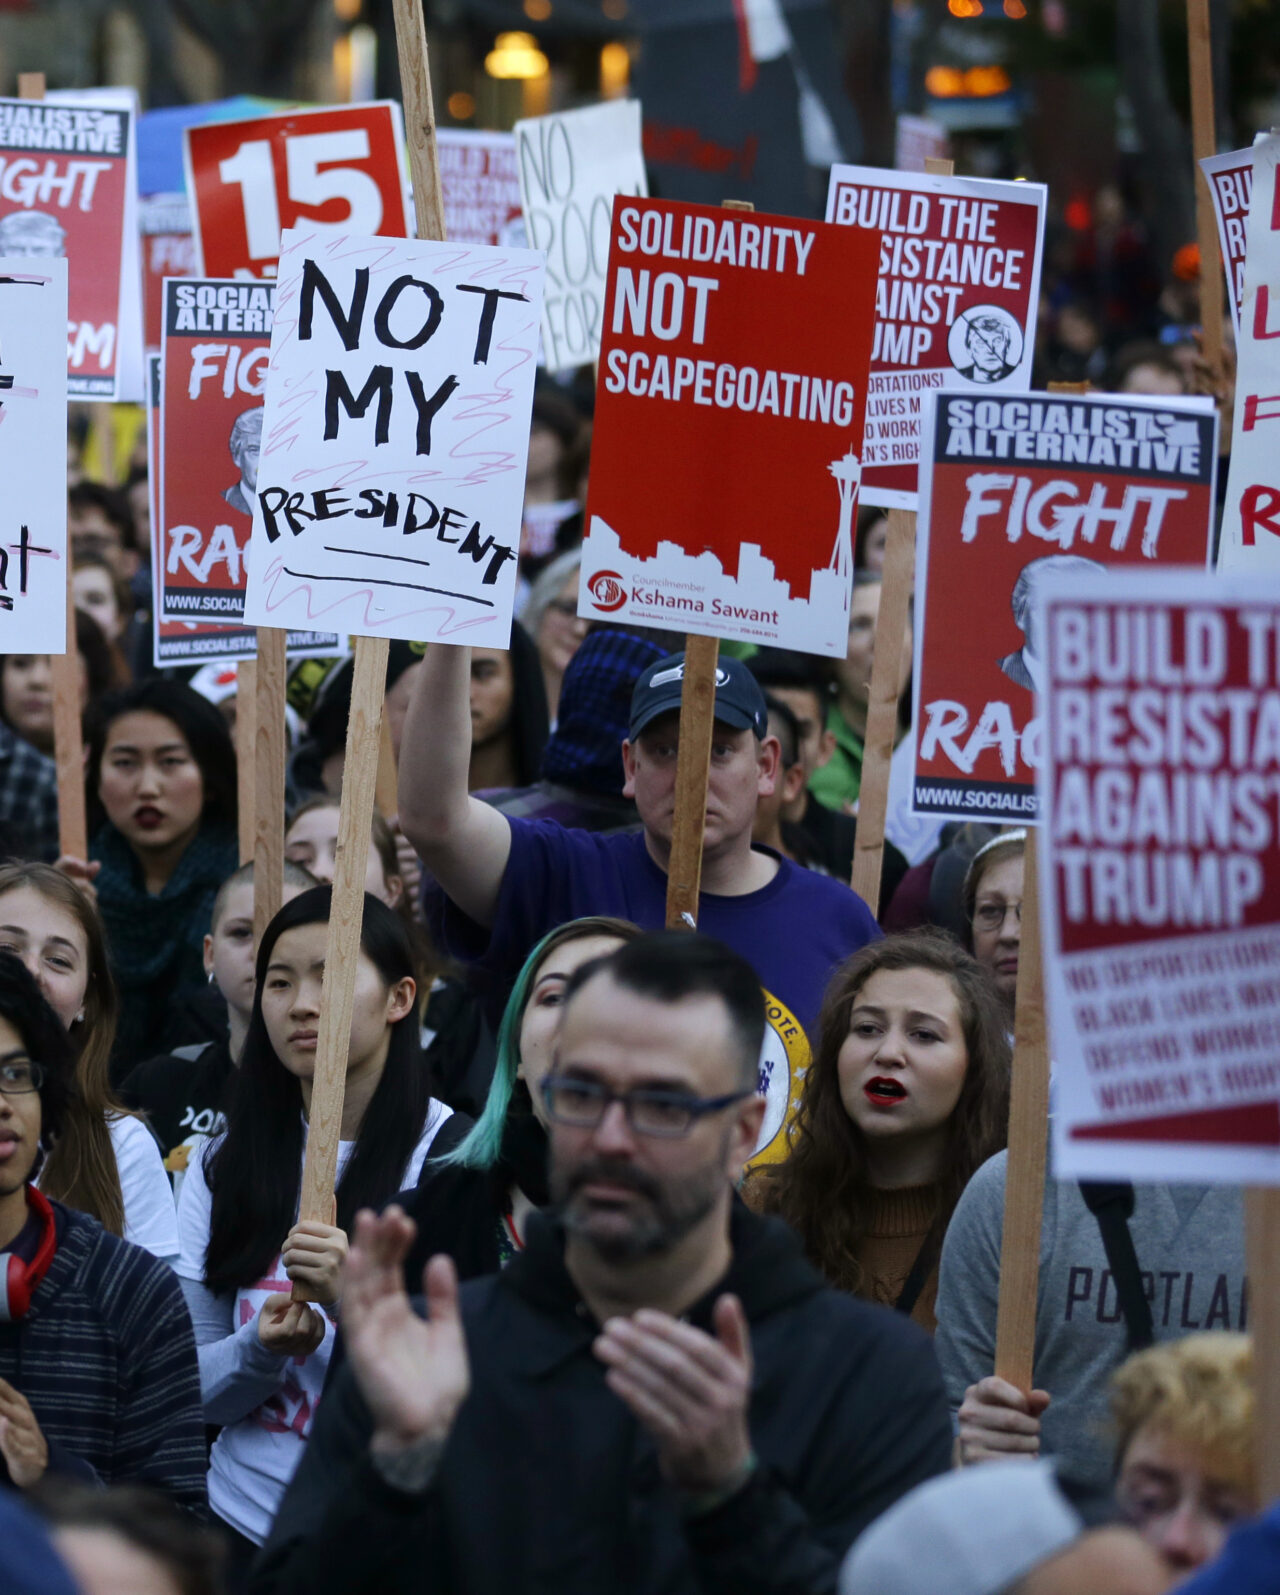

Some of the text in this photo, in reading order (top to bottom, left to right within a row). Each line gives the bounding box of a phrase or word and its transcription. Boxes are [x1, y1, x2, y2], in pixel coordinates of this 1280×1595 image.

[219, 128, 384, 261] 15
[520, 118, 575, 205] NO
[528, 184, 640, 290] ROO
[617, 207, 816, 276] SOLIDARITY
[836, 186, 999, 243] BUILD THE
[879, 234, 1024, 290] SISTANCE
[298, 259, 531, 366] NOT
[611, 267, 719, 345] NOT
[875, 278, 964, 327] AINST
[188, 342, 270, 400] FIG
[870, 322, 932, 366] UMP
[323, 365, 460, 457] MY
[604, 348, 855, 428] SCAPEGOATING
[867, 372, 944, 395] ORTATIONS!
[867, 396, 906, 417] LIVES
[877, 419, 920, 439] WORK
[945, 428, 1201, 475] ALTERNATIVE
[947, 400, 1153, 441] SOCIALIST
[258, 486, 518, 585] PRESIDENT
[960, 472, 1189, 559] FIGHT
[631, 586, 705, 613] Kshama
[710, 599, 780, 626] Sawant
[632, 574, 706, 593] Councilmember
[1054, 607, 1228, 686] BUILD
[1054, 686, 1280, 767] RESISTA
[1058, 848, 1264, 927] TRUMP
